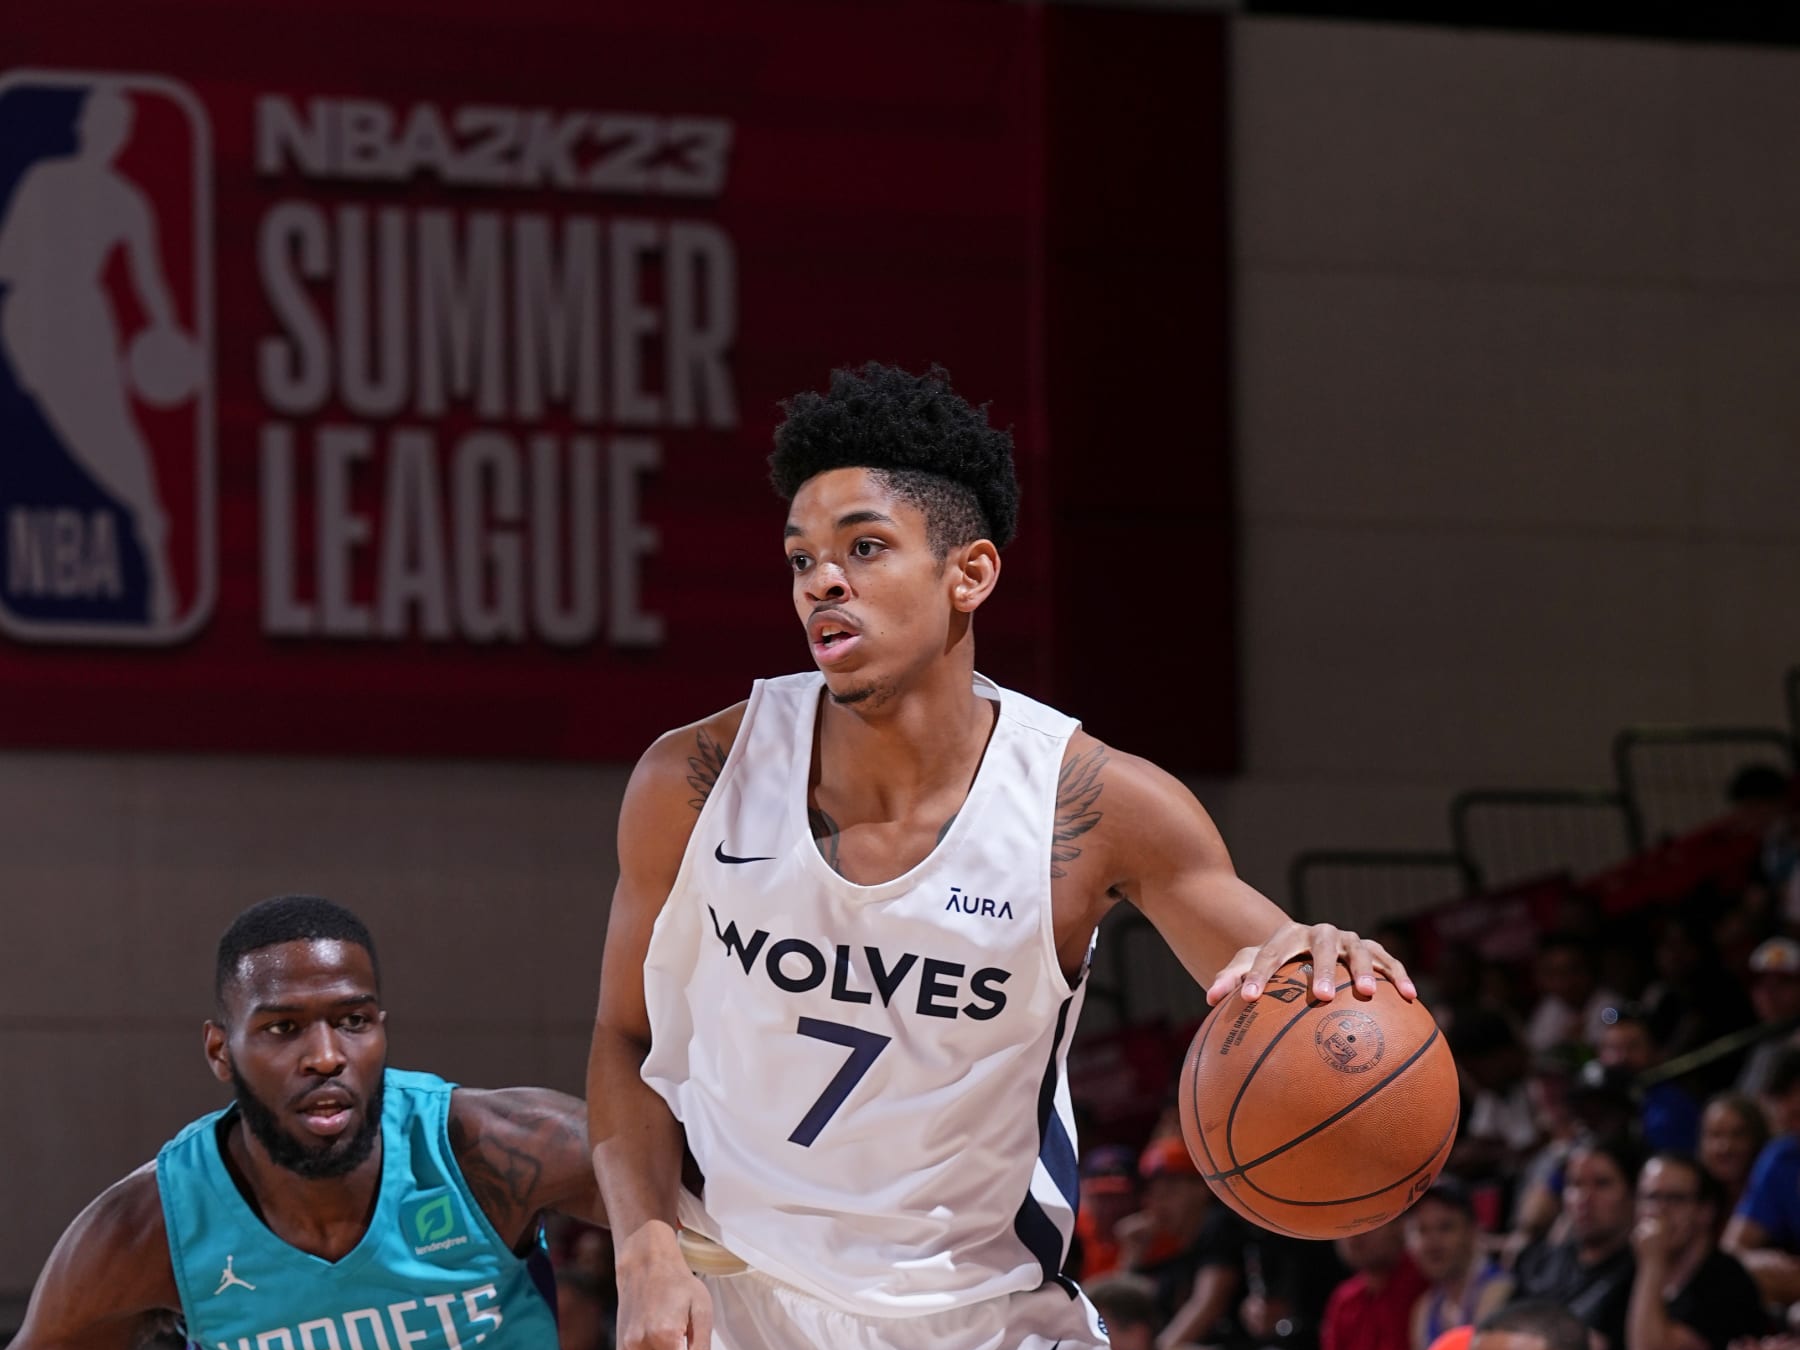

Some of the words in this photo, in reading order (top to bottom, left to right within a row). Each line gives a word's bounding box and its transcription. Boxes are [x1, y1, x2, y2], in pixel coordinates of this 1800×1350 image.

[255, 95, 736, 198] NBA2K23
[257, 203, 738, 428] SUMMER
[6, 506, 123, 599] NBA
[260, 425, 663, 647] LEAGUE
[707, 903, 1012, 1021] WOLVES
[787, 1015, 892, 1148] 7
[1220, 1029, 1238, 1055] OFFICIAL
[1234, 1011, 1249, 1028] GAME
[415, 1236, 468, 1256] lendingtree
